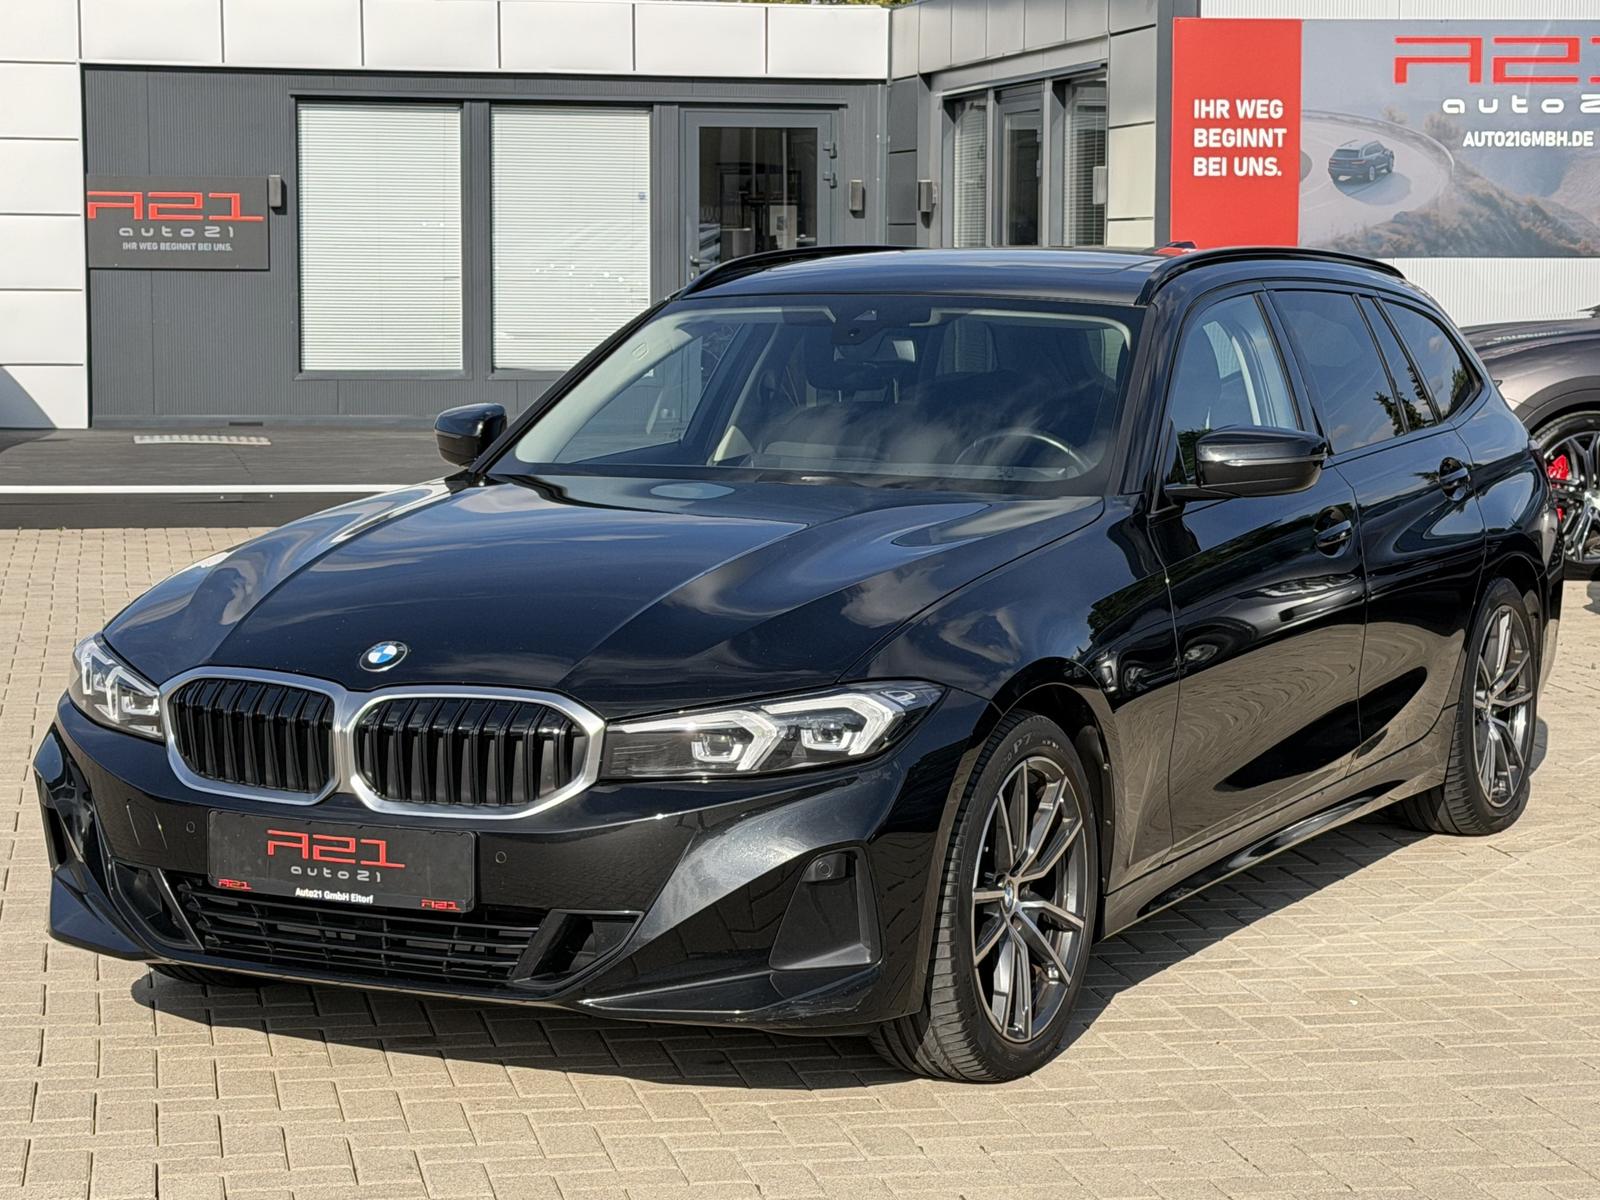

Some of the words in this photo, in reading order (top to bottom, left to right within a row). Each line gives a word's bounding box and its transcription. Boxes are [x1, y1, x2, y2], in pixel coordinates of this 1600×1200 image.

[1394, 36, 1600, 84] A2
[1194, 99, 1230, 119] IHR
[1236, 99, 1284, 119] WEG
[1193, 128, 1287, 148] BEGINNT
[1462, 130, 1594, 147] AUTO21GMBH.DE
[1193, 157, 1227, 176] BEI
[1234, 156, 1282, 176] UNS.
[87, 191, 264, 221] A21
[118, 225, 234, 237] auto21
[122, 242, 137, 250] IHR
[139, 242, 158, 250] WEG
[160, 242, 197, 251] BEGINNT
[198, 242, 212, 251] BEI
[213, 243, 233, 251] UNS.
[267, 829, 405, 868] A21
[290, 866, 381, 882] auto21
[295, 887, 322, 898] Auto21
[323, 890, 349, 901] GmbH
